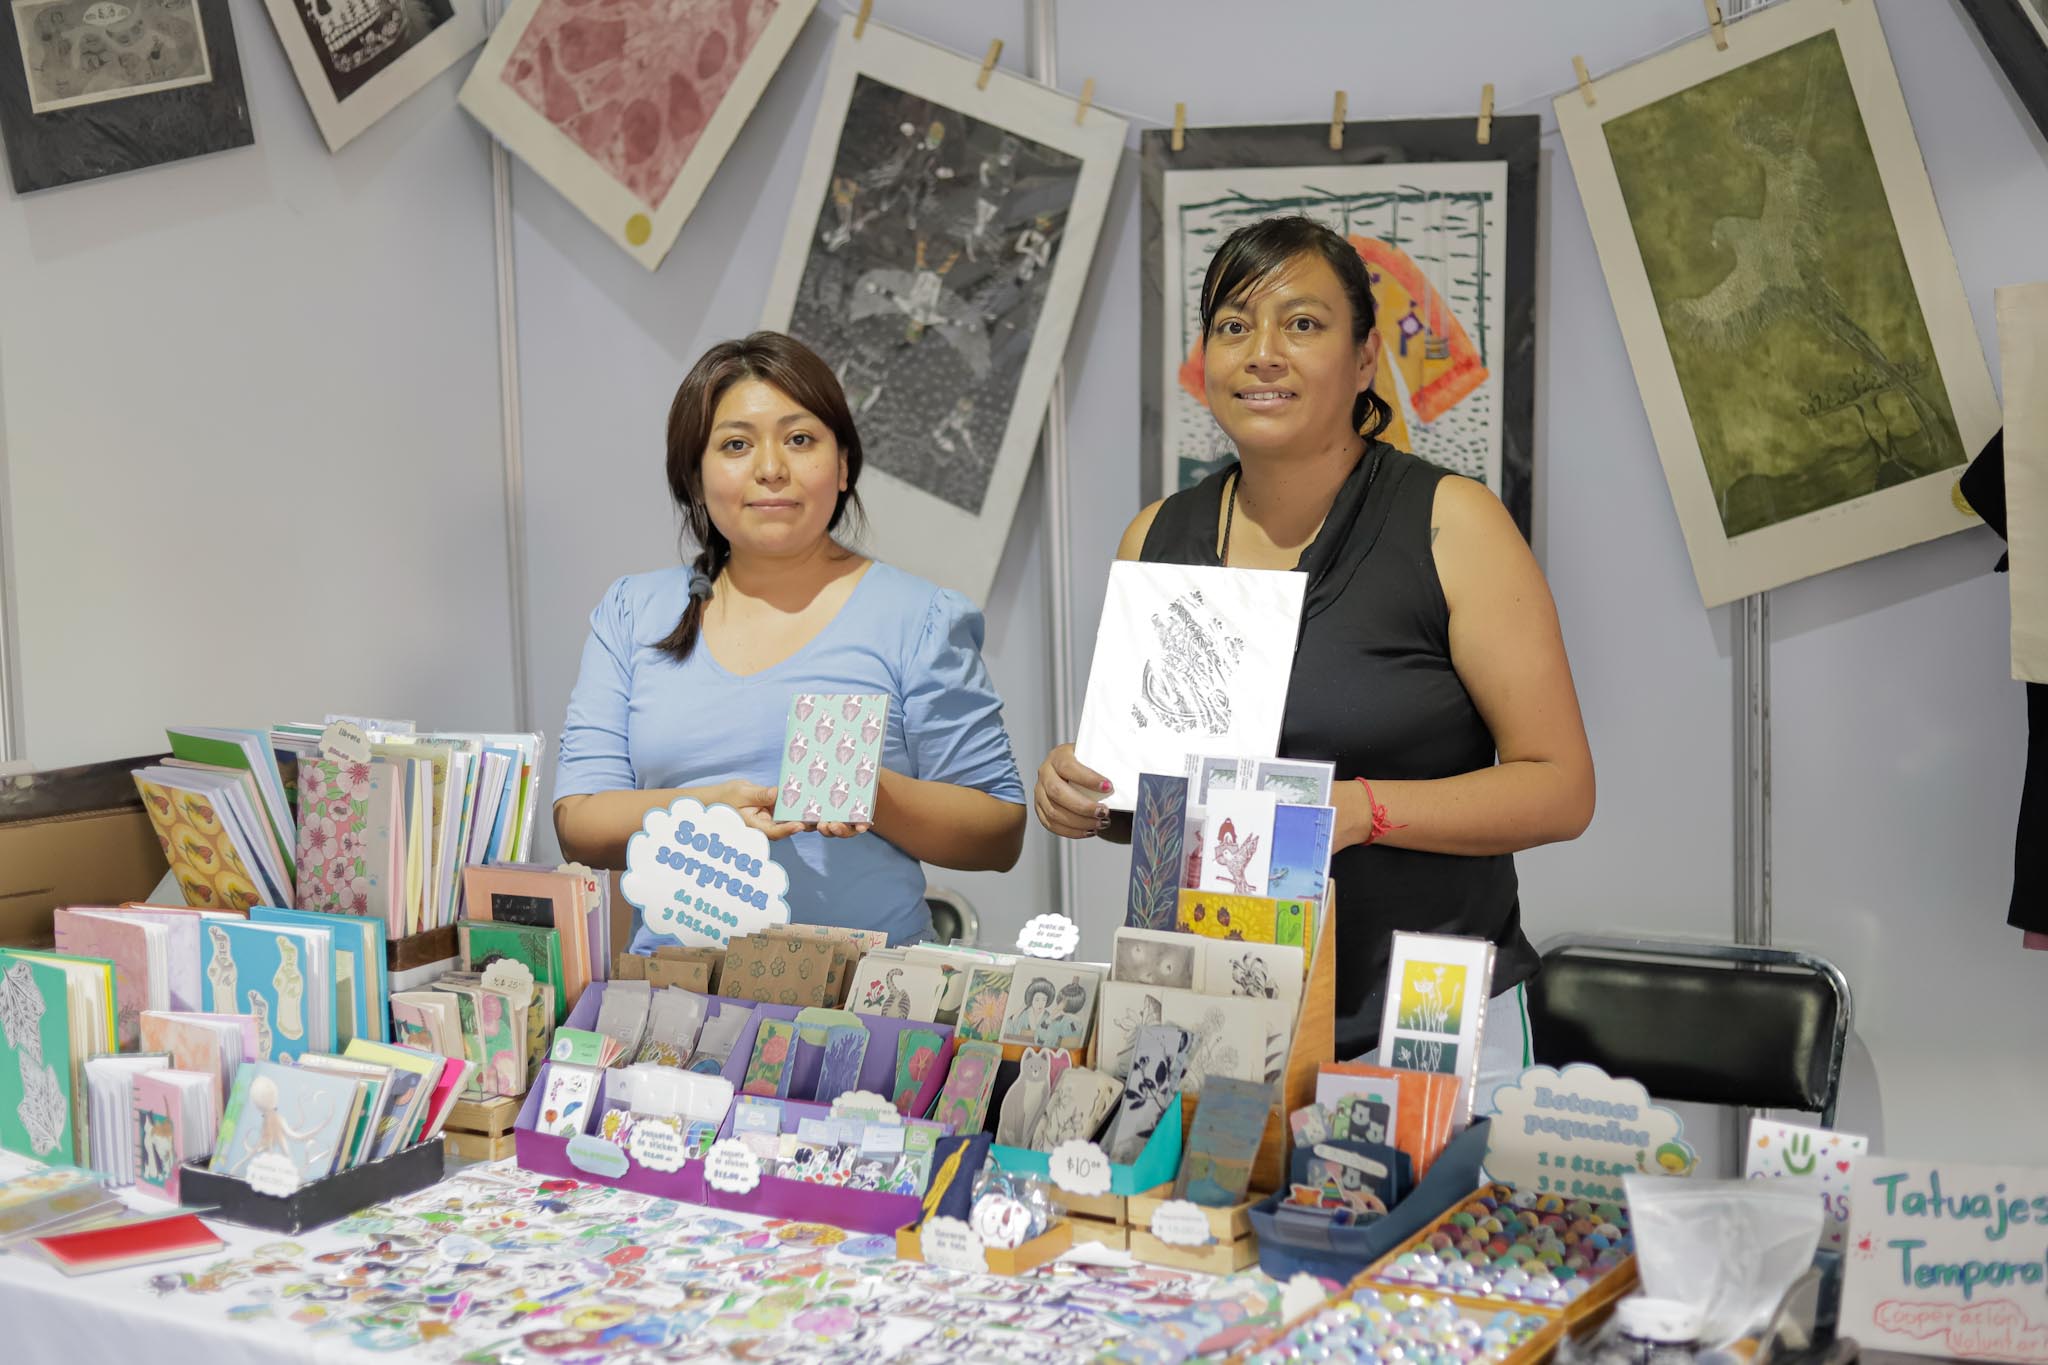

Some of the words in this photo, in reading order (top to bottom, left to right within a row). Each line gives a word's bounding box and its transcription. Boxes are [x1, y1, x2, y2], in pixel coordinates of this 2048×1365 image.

[675, 820, 763, 877] Sobres
[656, 846, 769, 910] sorpresa
[662, 907, 674, 920] y
[676, 910, 720, 940] $25.00
[674, 889, 692, 905] de
[694, 897, 738, 927] $10.00
[1534, 1086, 1638, 1121] Botones
[1524, 1114, 1650, 1147] pequeños
[1873, 1169, 2048, 1240] Tatuajes
